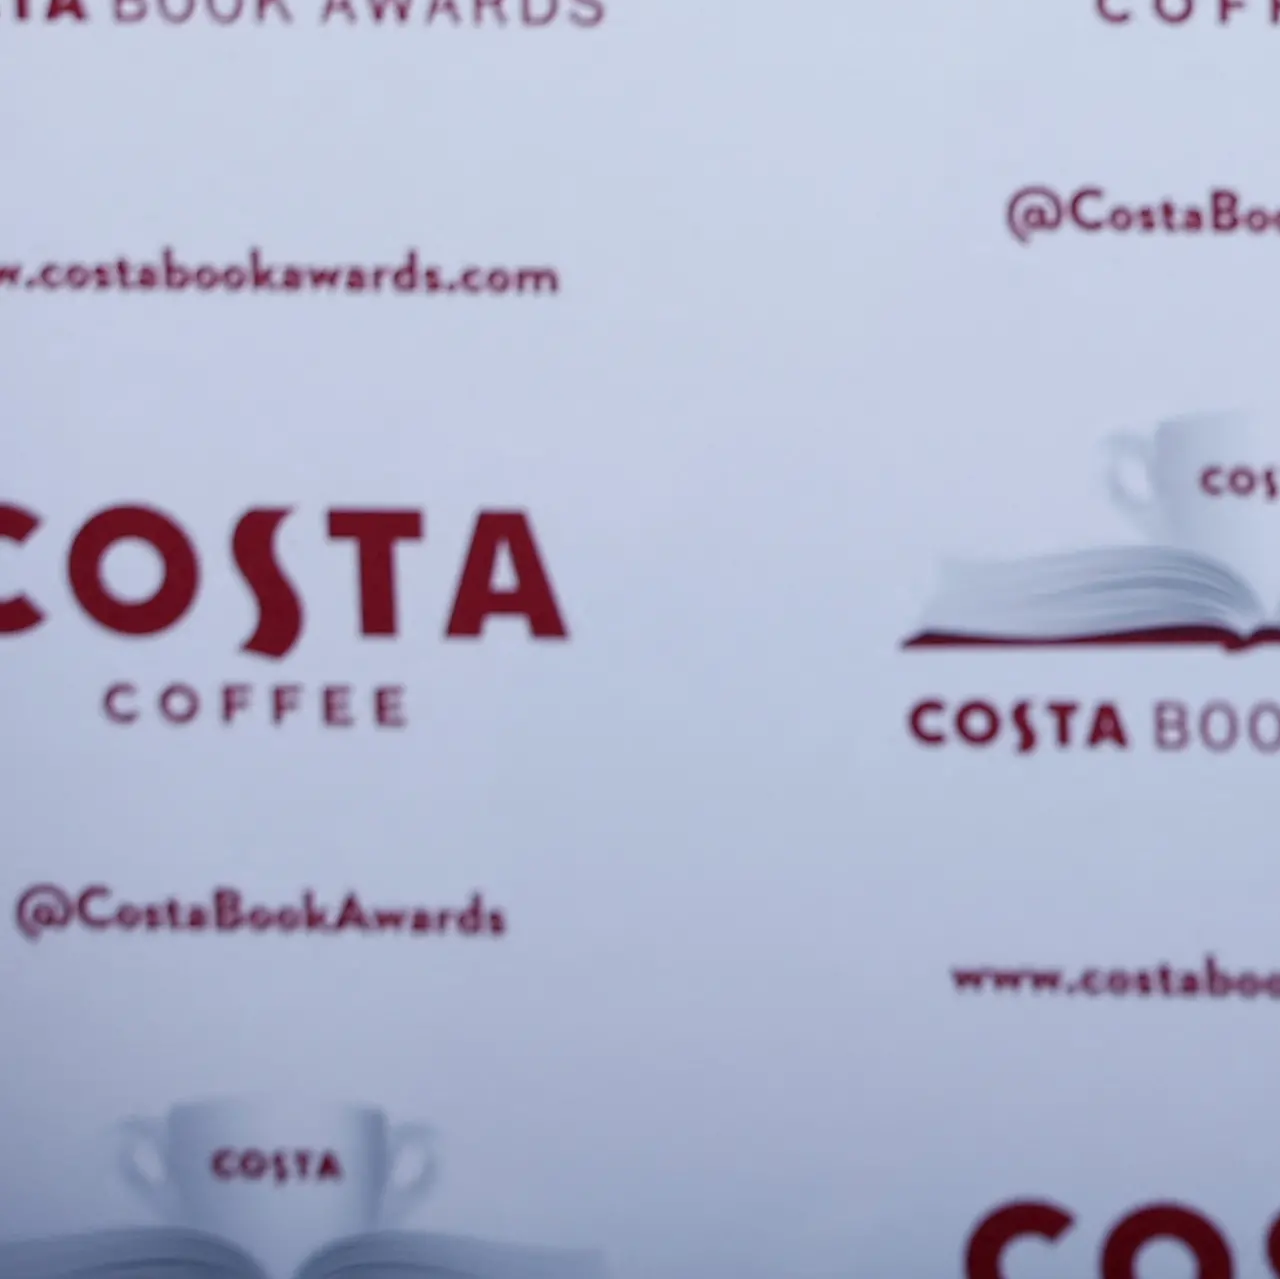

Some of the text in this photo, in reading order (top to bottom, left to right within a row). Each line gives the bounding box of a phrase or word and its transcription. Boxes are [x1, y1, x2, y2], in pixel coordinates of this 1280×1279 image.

[103, 683, 403, 727] COFFEE
[908, 699, 1128, 753] COSTA
[16, 885, 506, 937] @CostaBookAwards
[211, 1150, 342, 1183] COSTA
